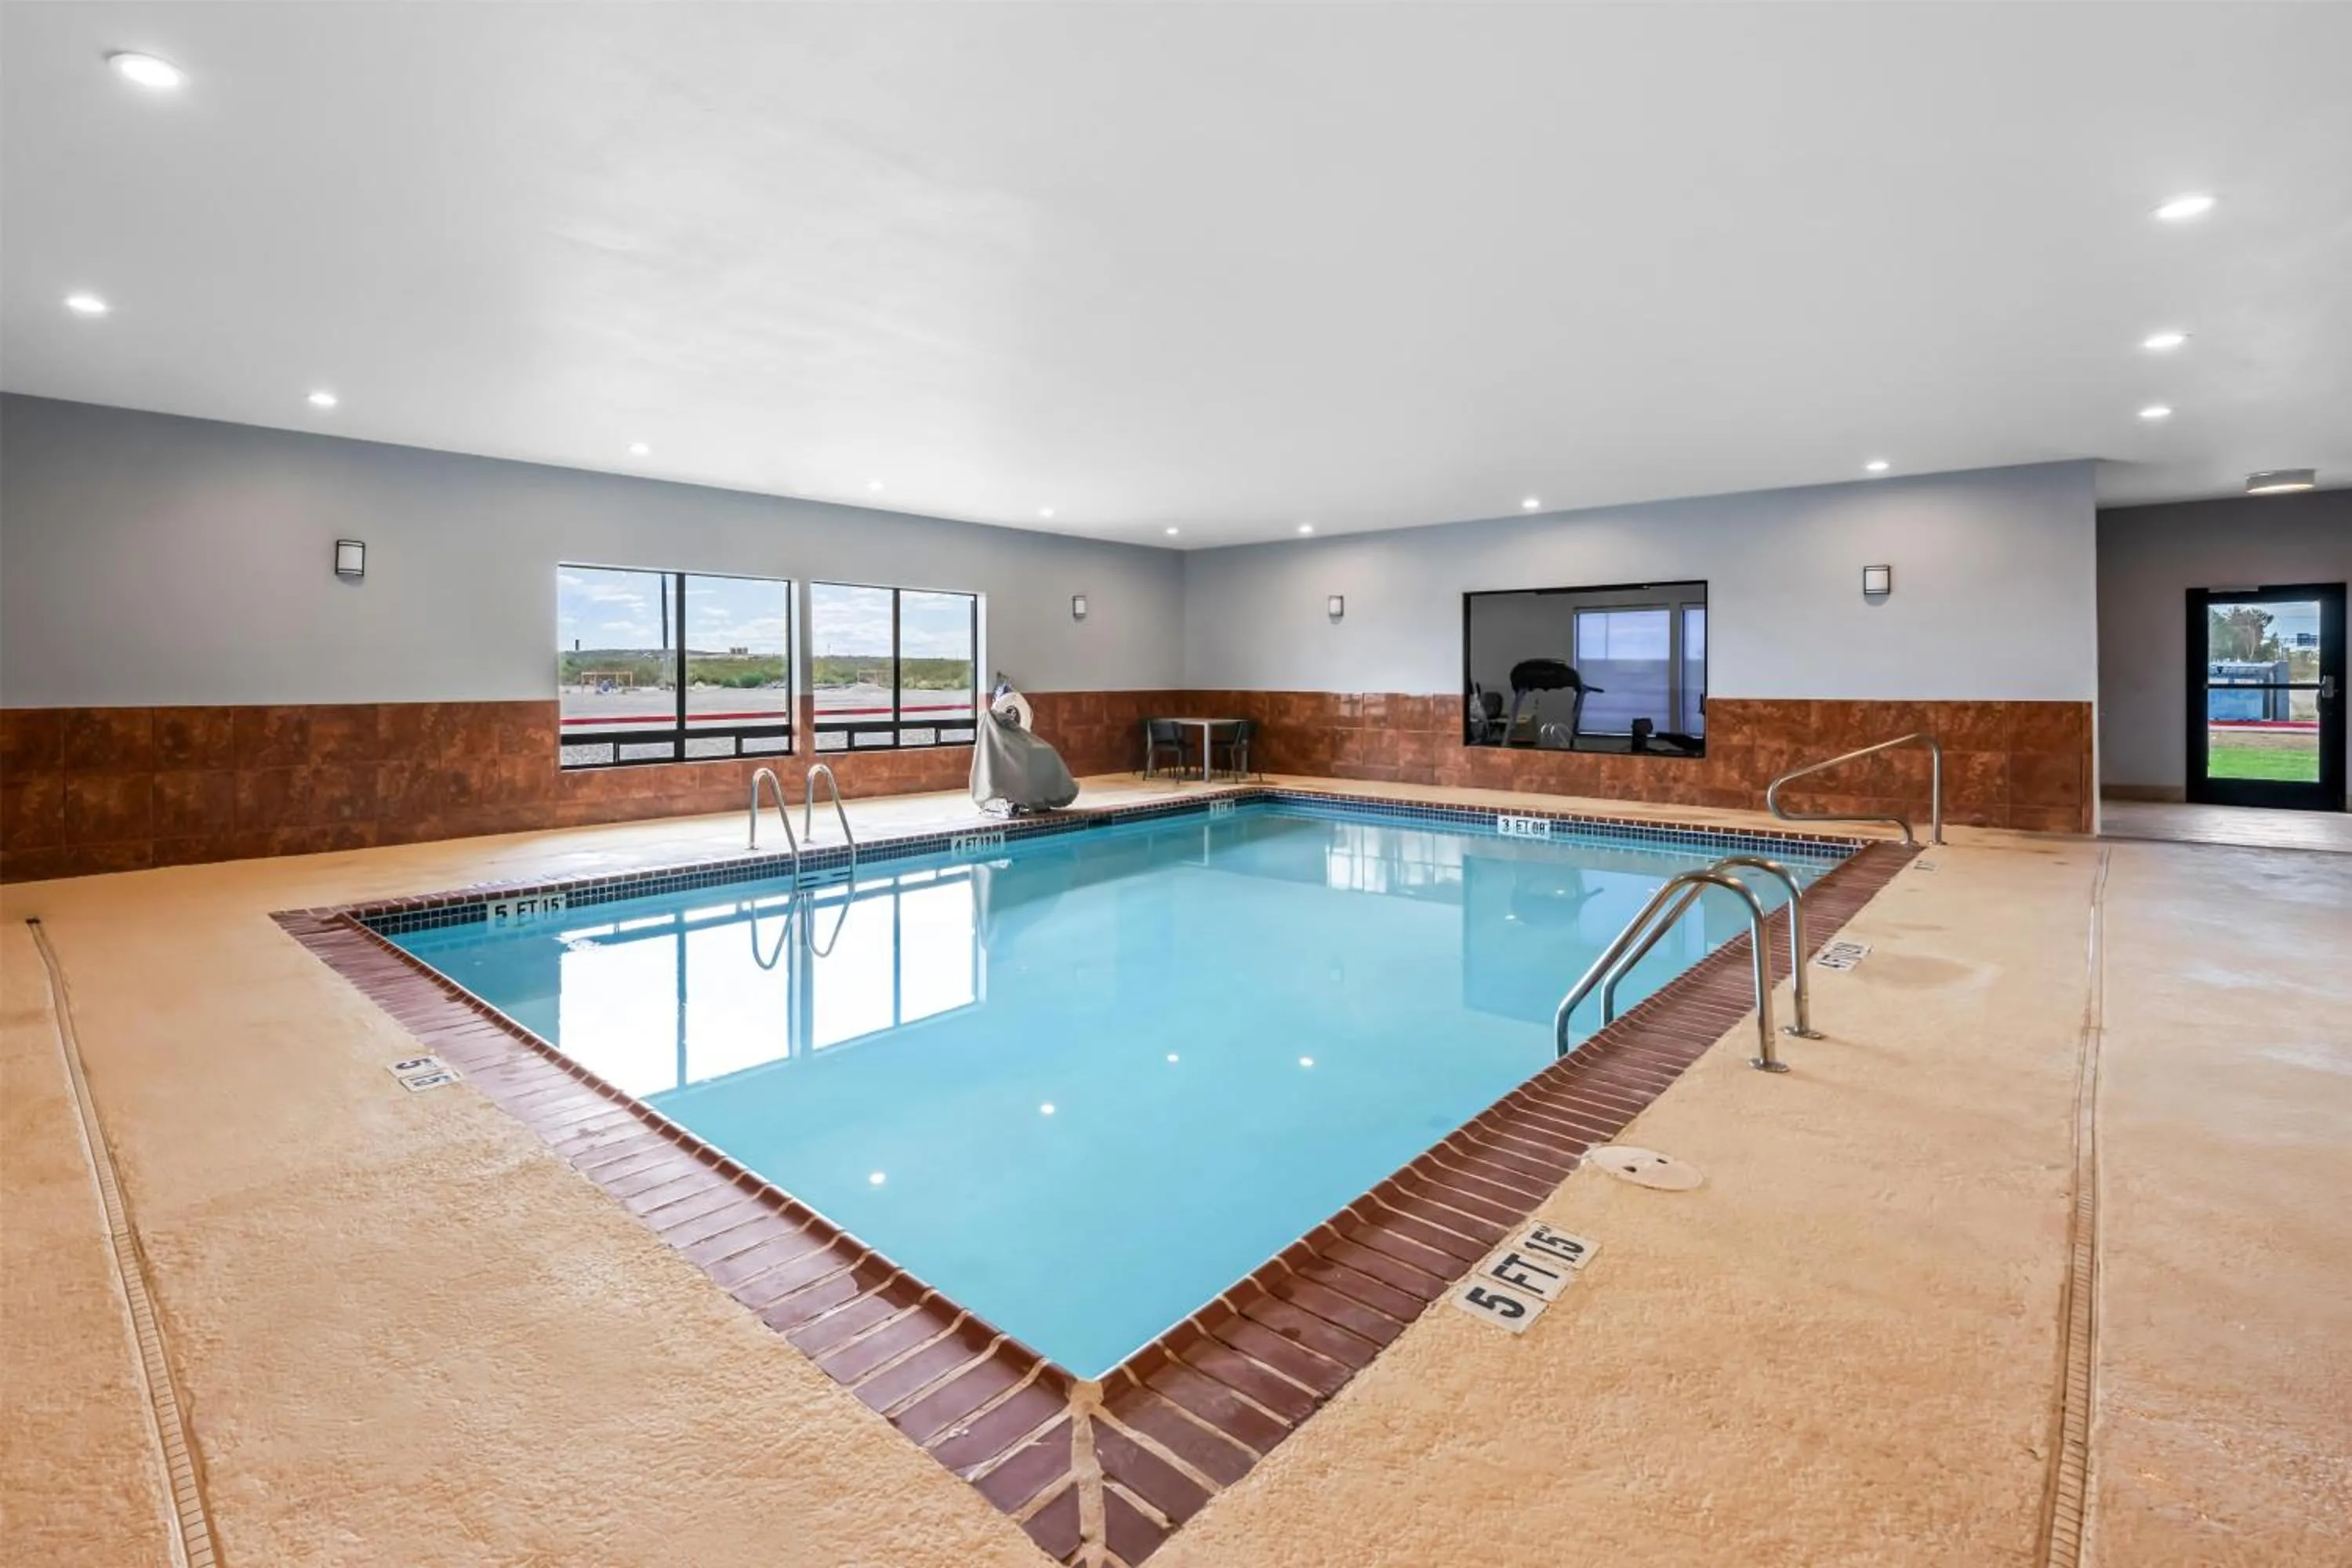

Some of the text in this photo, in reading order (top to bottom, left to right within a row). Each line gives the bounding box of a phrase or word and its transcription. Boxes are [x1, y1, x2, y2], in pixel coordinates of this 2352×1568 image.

[495, 905, 508, 920] 5
[517, 899, 539, 916] FT
[1491, 1253, 1559, 1294] FT
[1465, 1287, 1526, 1319] 5
